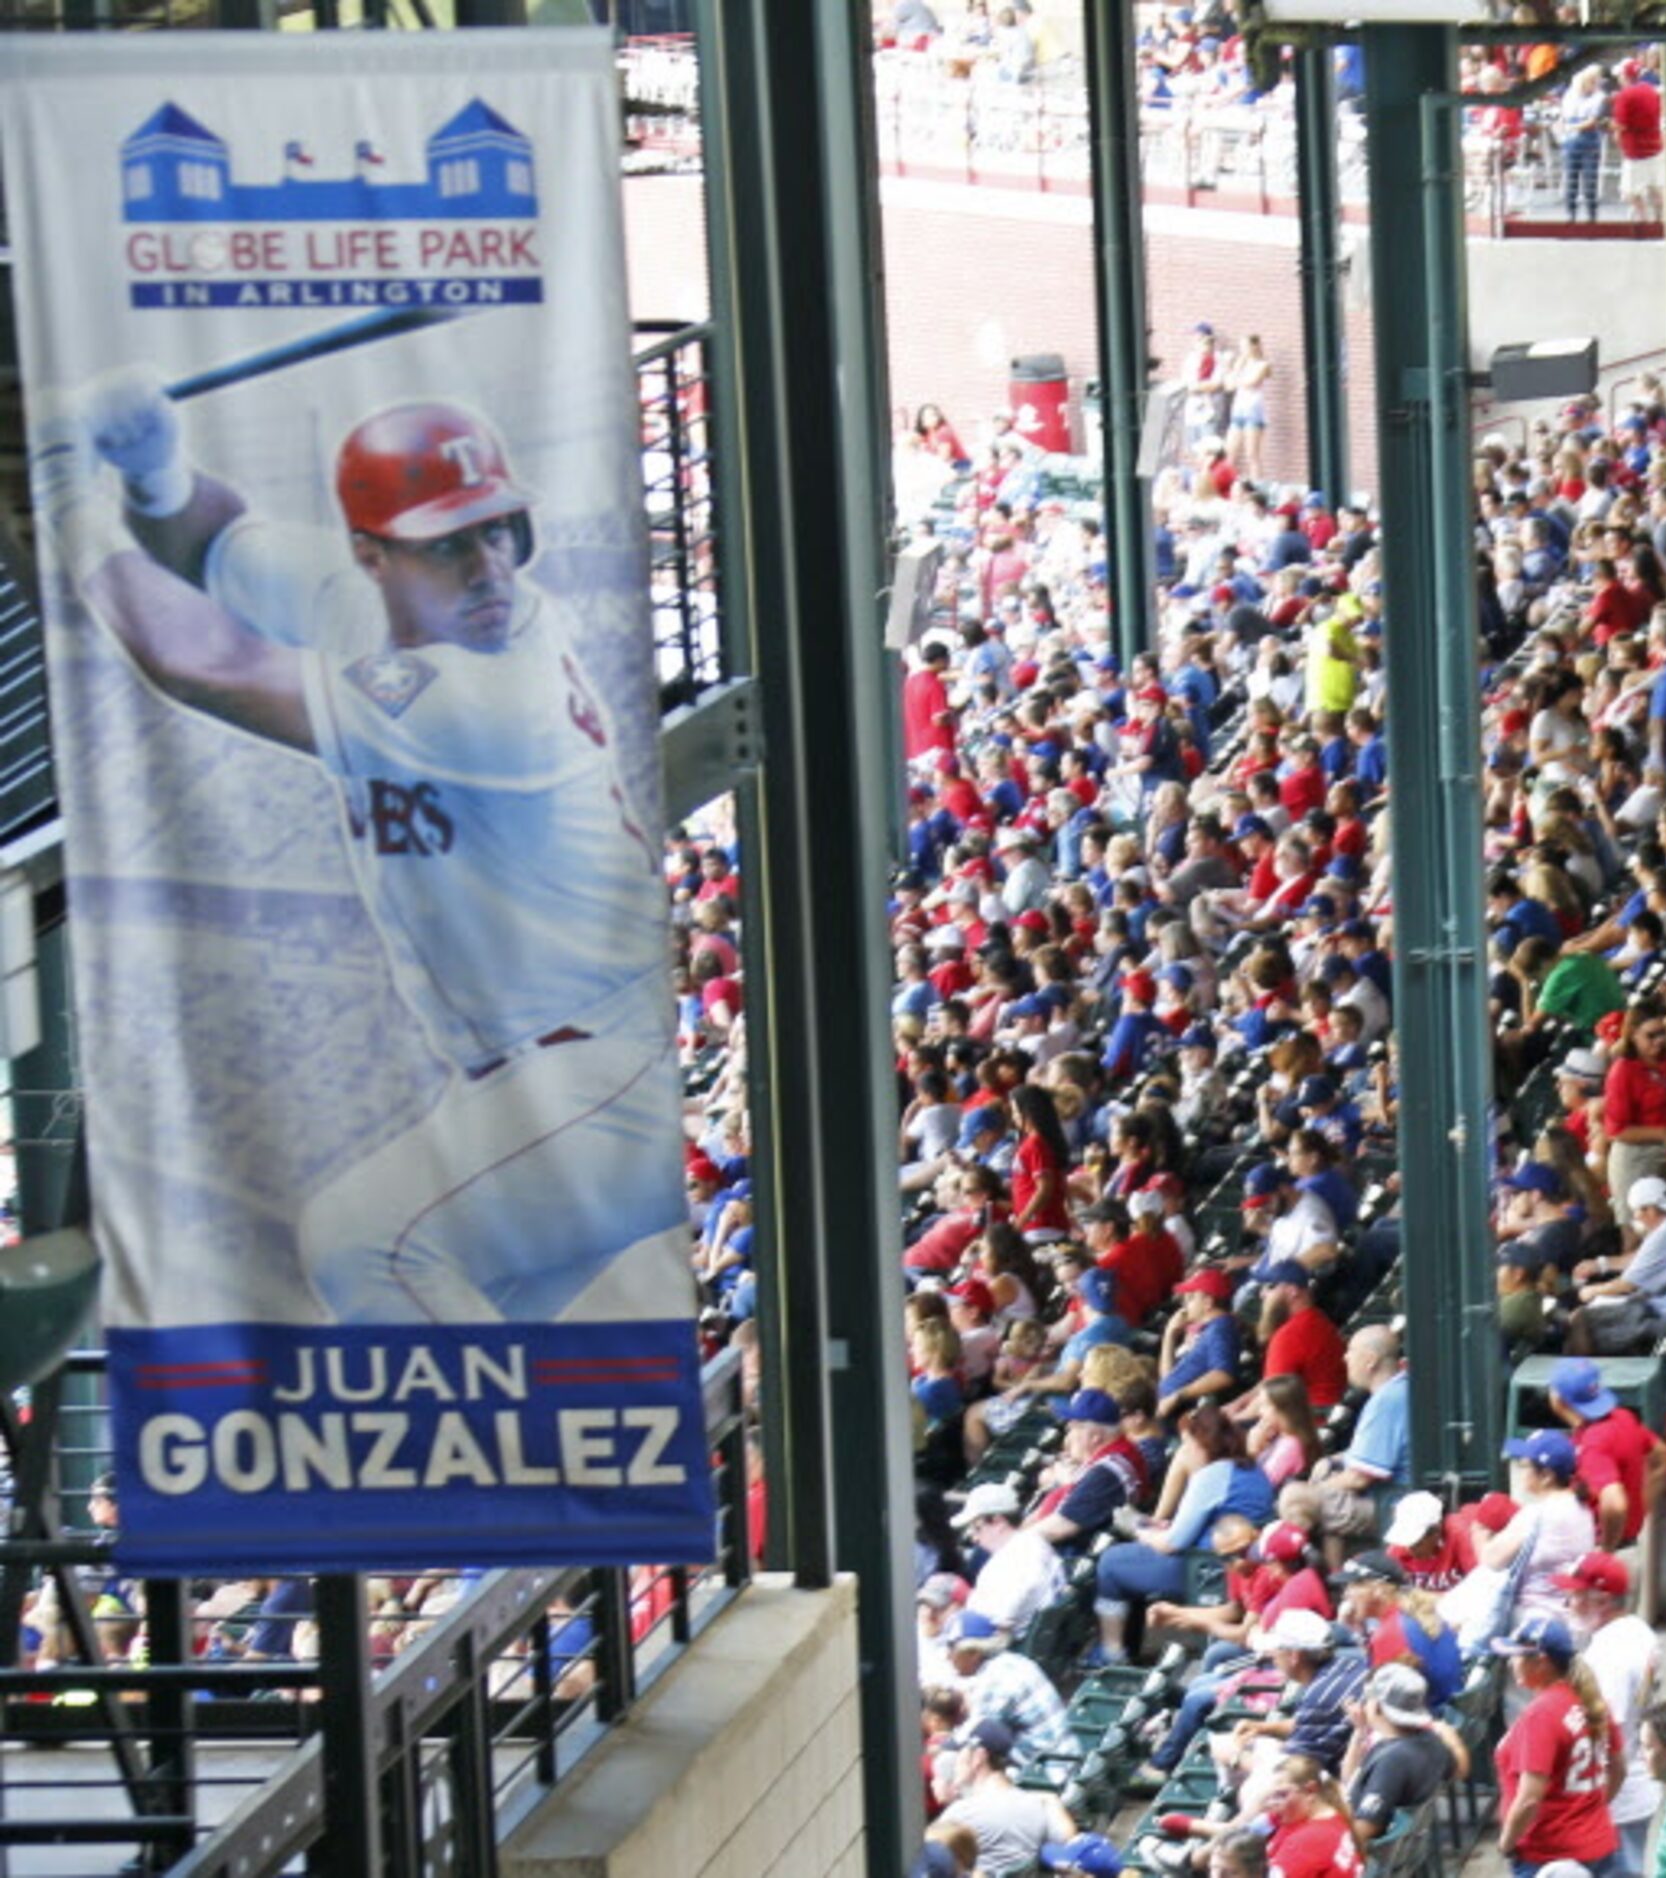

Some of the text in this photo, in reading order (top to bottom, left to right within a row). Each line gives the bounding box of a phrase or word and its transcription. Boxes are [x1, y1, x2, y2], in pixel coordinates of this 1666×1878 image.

[306, 230, 400, 271] LIFE
[418, 228, 540, 268] PARK
[163, 278, 503, 305] IN ARLINGTON
[273, 1344, 529, 1401] JUAN
[138, 1406, 687, 1495] GONZALEZ
